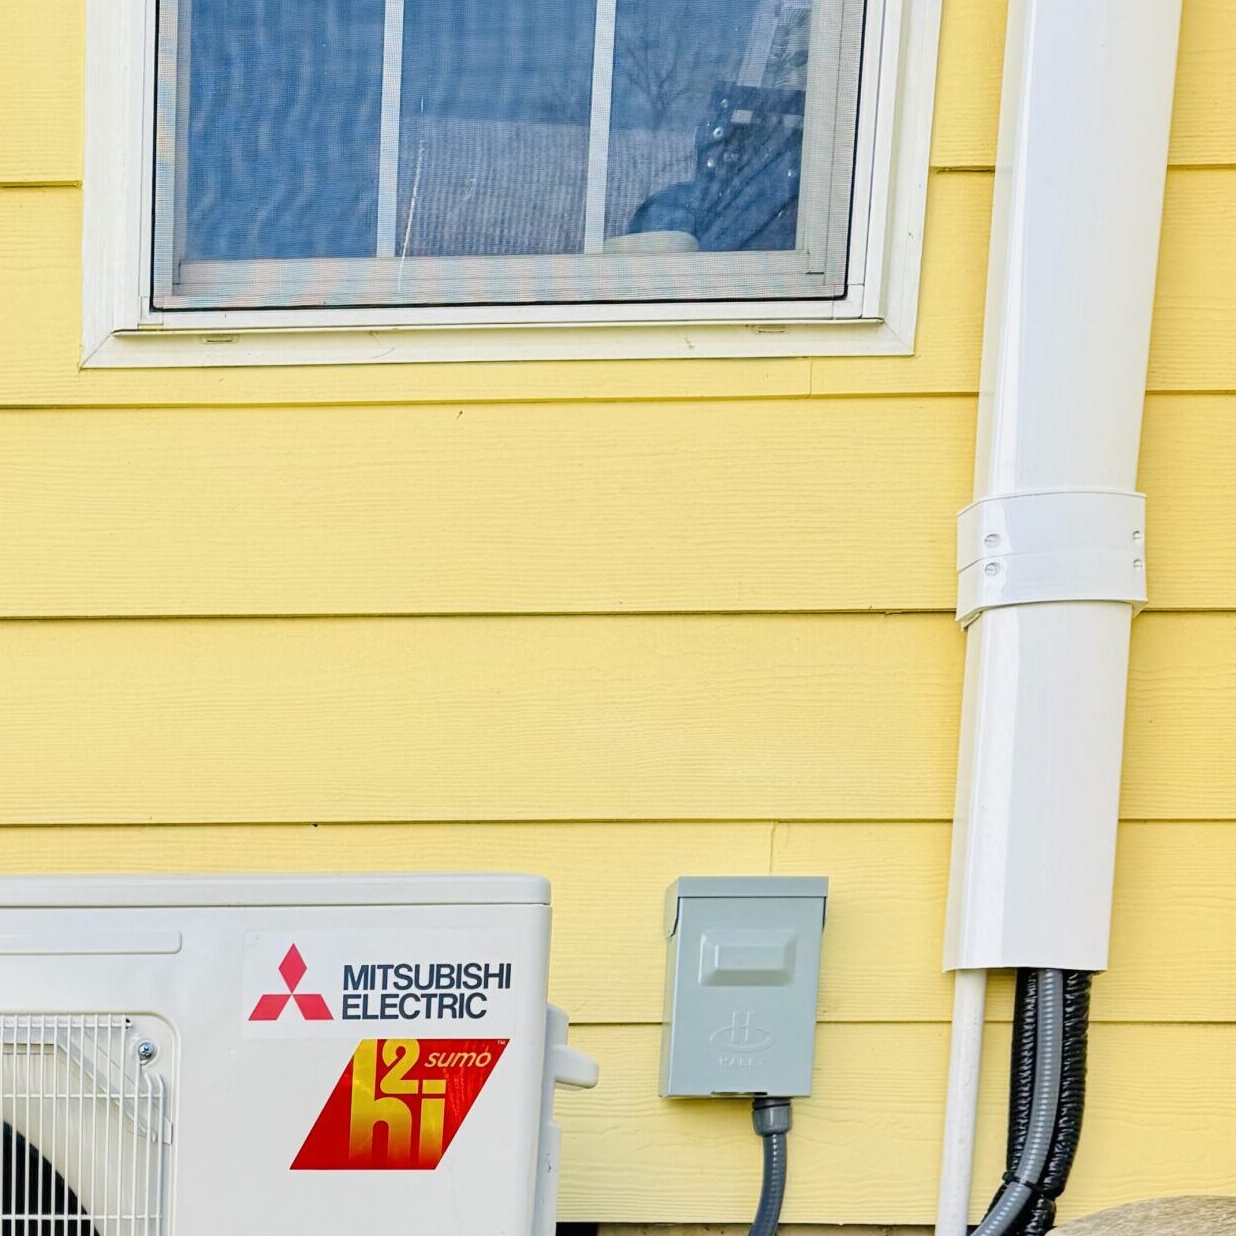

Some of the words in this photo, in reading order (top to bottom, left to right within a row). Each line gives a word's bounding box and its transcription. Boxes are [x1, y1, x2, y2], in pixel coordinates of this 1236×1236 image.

[343, 963, 512, 990] MITSUBISHI
[342, 992, 488, 1020] ELECTRIC
[424, 1052, 492, 1068] sumo
